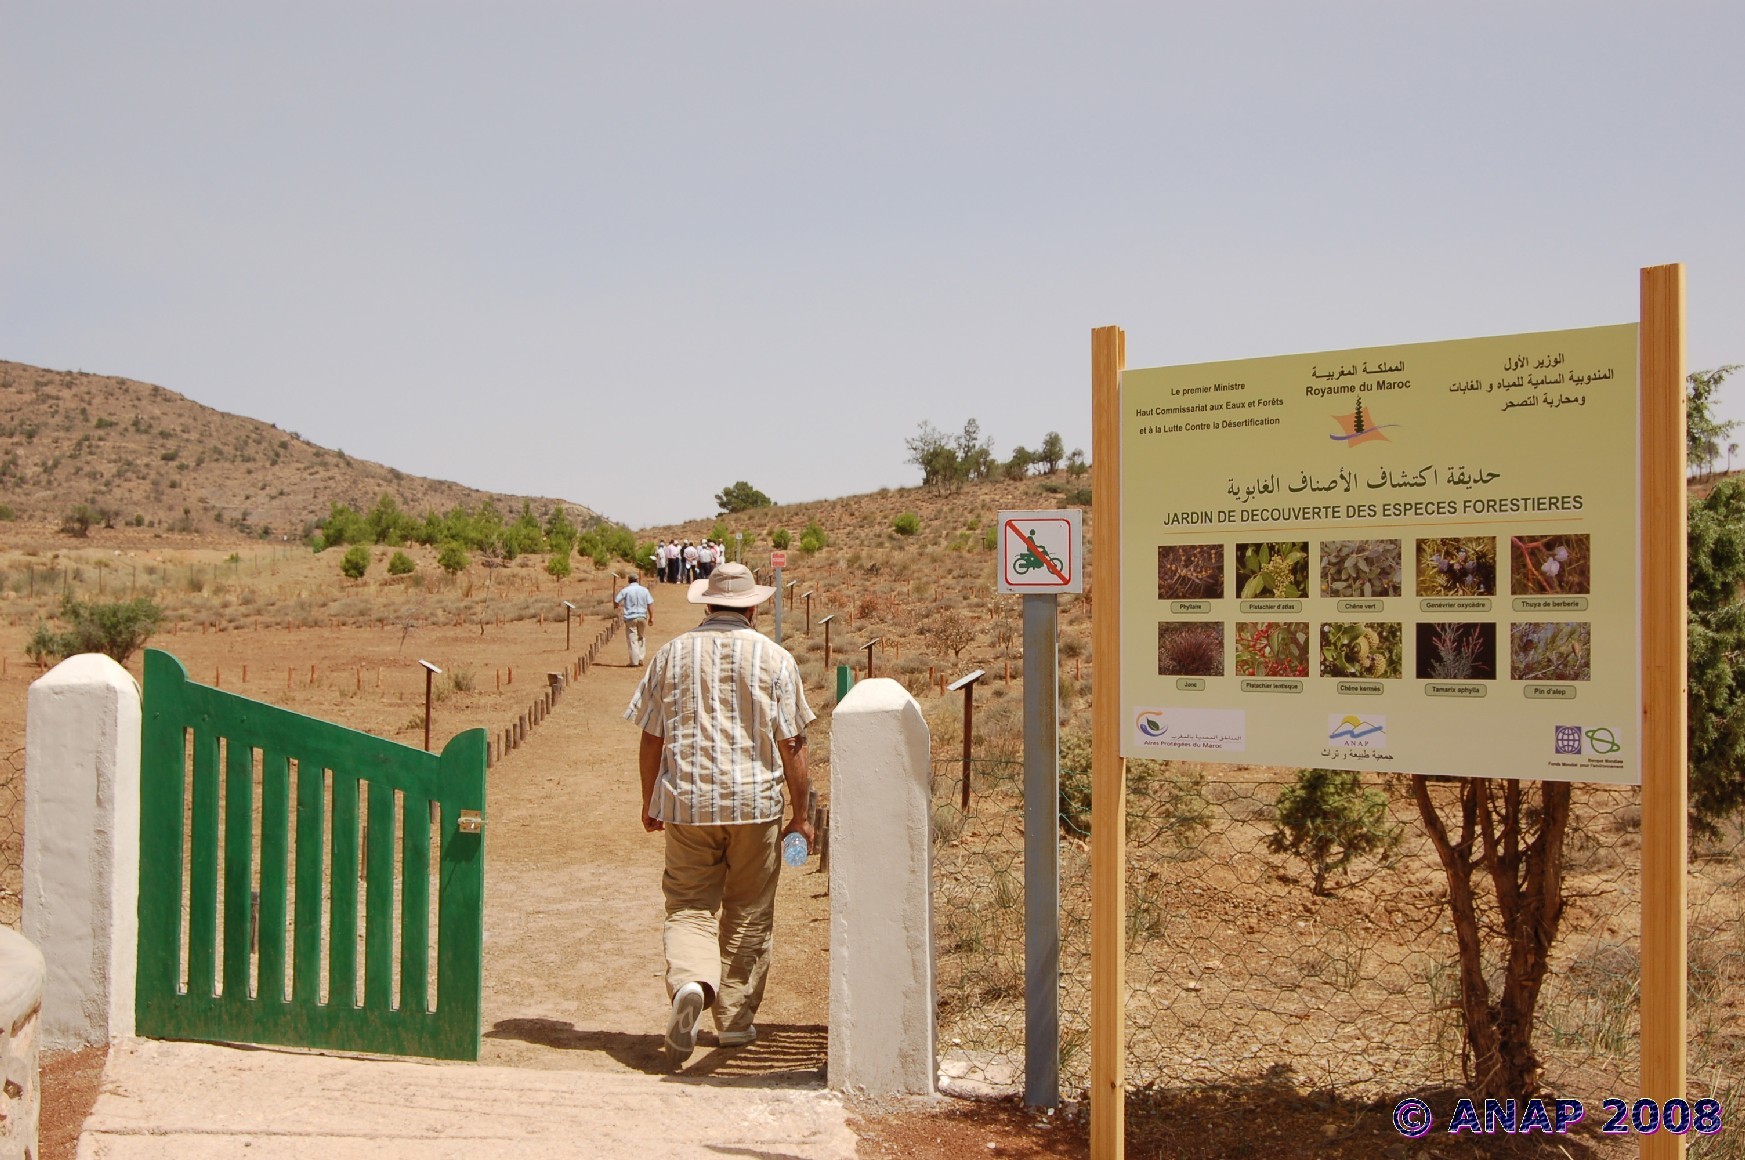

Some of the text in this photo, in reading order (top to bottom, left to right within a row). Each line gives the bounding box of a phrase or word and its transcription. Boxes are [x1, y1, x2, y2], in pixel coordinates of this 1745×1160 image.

[1312, 361, 1404, 381] المملكة المغربية
[1504, 354, 1564, 372] الوزير الأول
[1171, 382, 1245, 396] Le premier Ministre
[1305, 379, 1411, 398] Royaume du Maroc
[1449, 368, 1614, 394] المندوبية السامية للمياه و الغابات
[1136, 407, 1153, 416] Haut
[1155, 403, 1208, 415] Commissariat
[1210, 403, 1223, 411] aux
[1226, 400, 1246, 410] Eaux
[1258, 397, 1284, 407] Forêts
[1501, 394, 1586, 412] ومحاربة التصحر
[1148, 425, 1153, 434] à
[1156, 425, 1162, 434] la
[1164, 423, 1183, 433] Lutte
[1185, 421, 1211, 432] Contre
[1213, 421, 1220, 430] la
[1222, 417, 1280, 429] Désertification
[1227, 465, 1501, 503] حديقة اكتشاف الأصناف الغابوية
[1164, 495, 1583, 525] JARDIN DE DECOUVERTE DES ESPECES FORESTIERES
